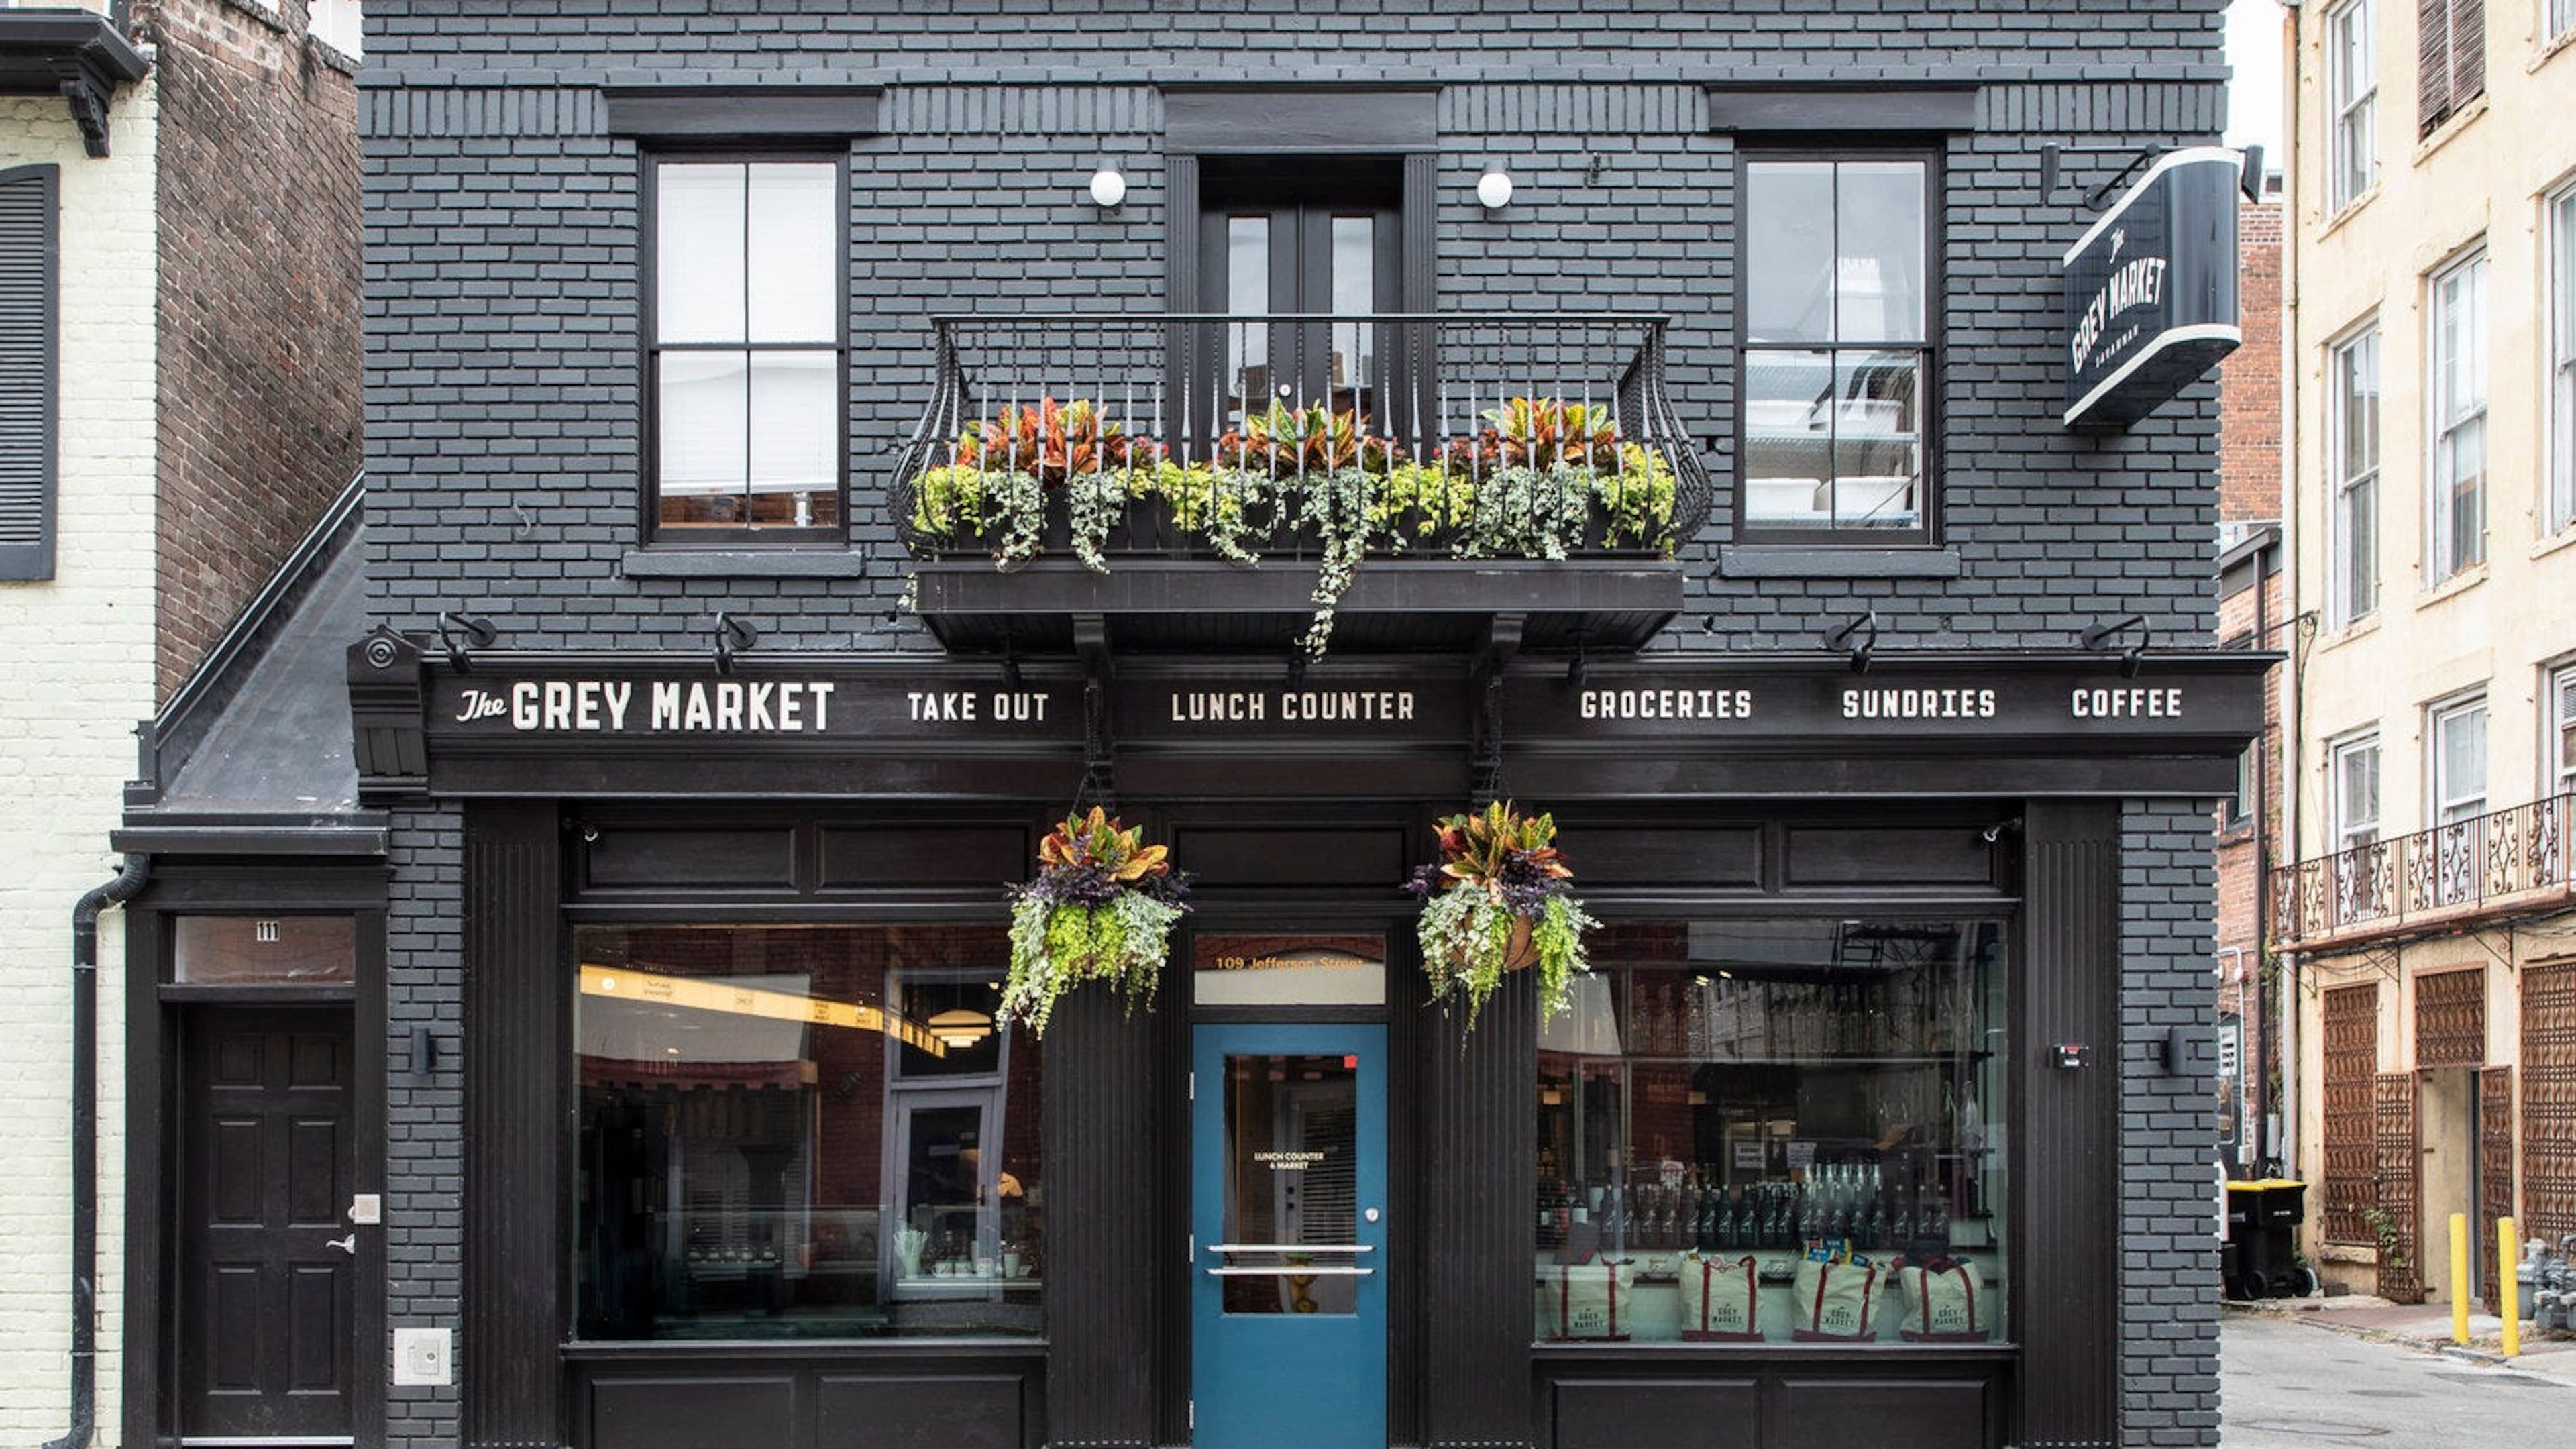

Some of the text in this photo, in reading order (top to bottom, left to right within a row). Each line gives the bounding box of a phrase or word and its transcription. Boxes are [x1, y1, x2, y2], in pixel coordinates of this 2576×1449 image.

[2109, 228, 2125, 264] The
[2072, 256, 2166, 374] GREY MARKET
[456, 681, 835, 731] The GREY MARKET
[908, 692, 1049, 721] TAKE OUT
[1172, 692, 1414, 721] LUNCH COUNTER
[1580, 690, 1752, 718] GROCERIES
[1843, 689, 1996, 718] SUNDRIES
[2072, 688, 2182, 717] COFFEE
[260, 922, 278, 939] 111
[1216, 957, 1364, 970] 109 Jefferson Street
[1254, 1152, 1324, 1161] LUNCH COUNTER
[1277, 1161, 1309, 1170] MARKET
